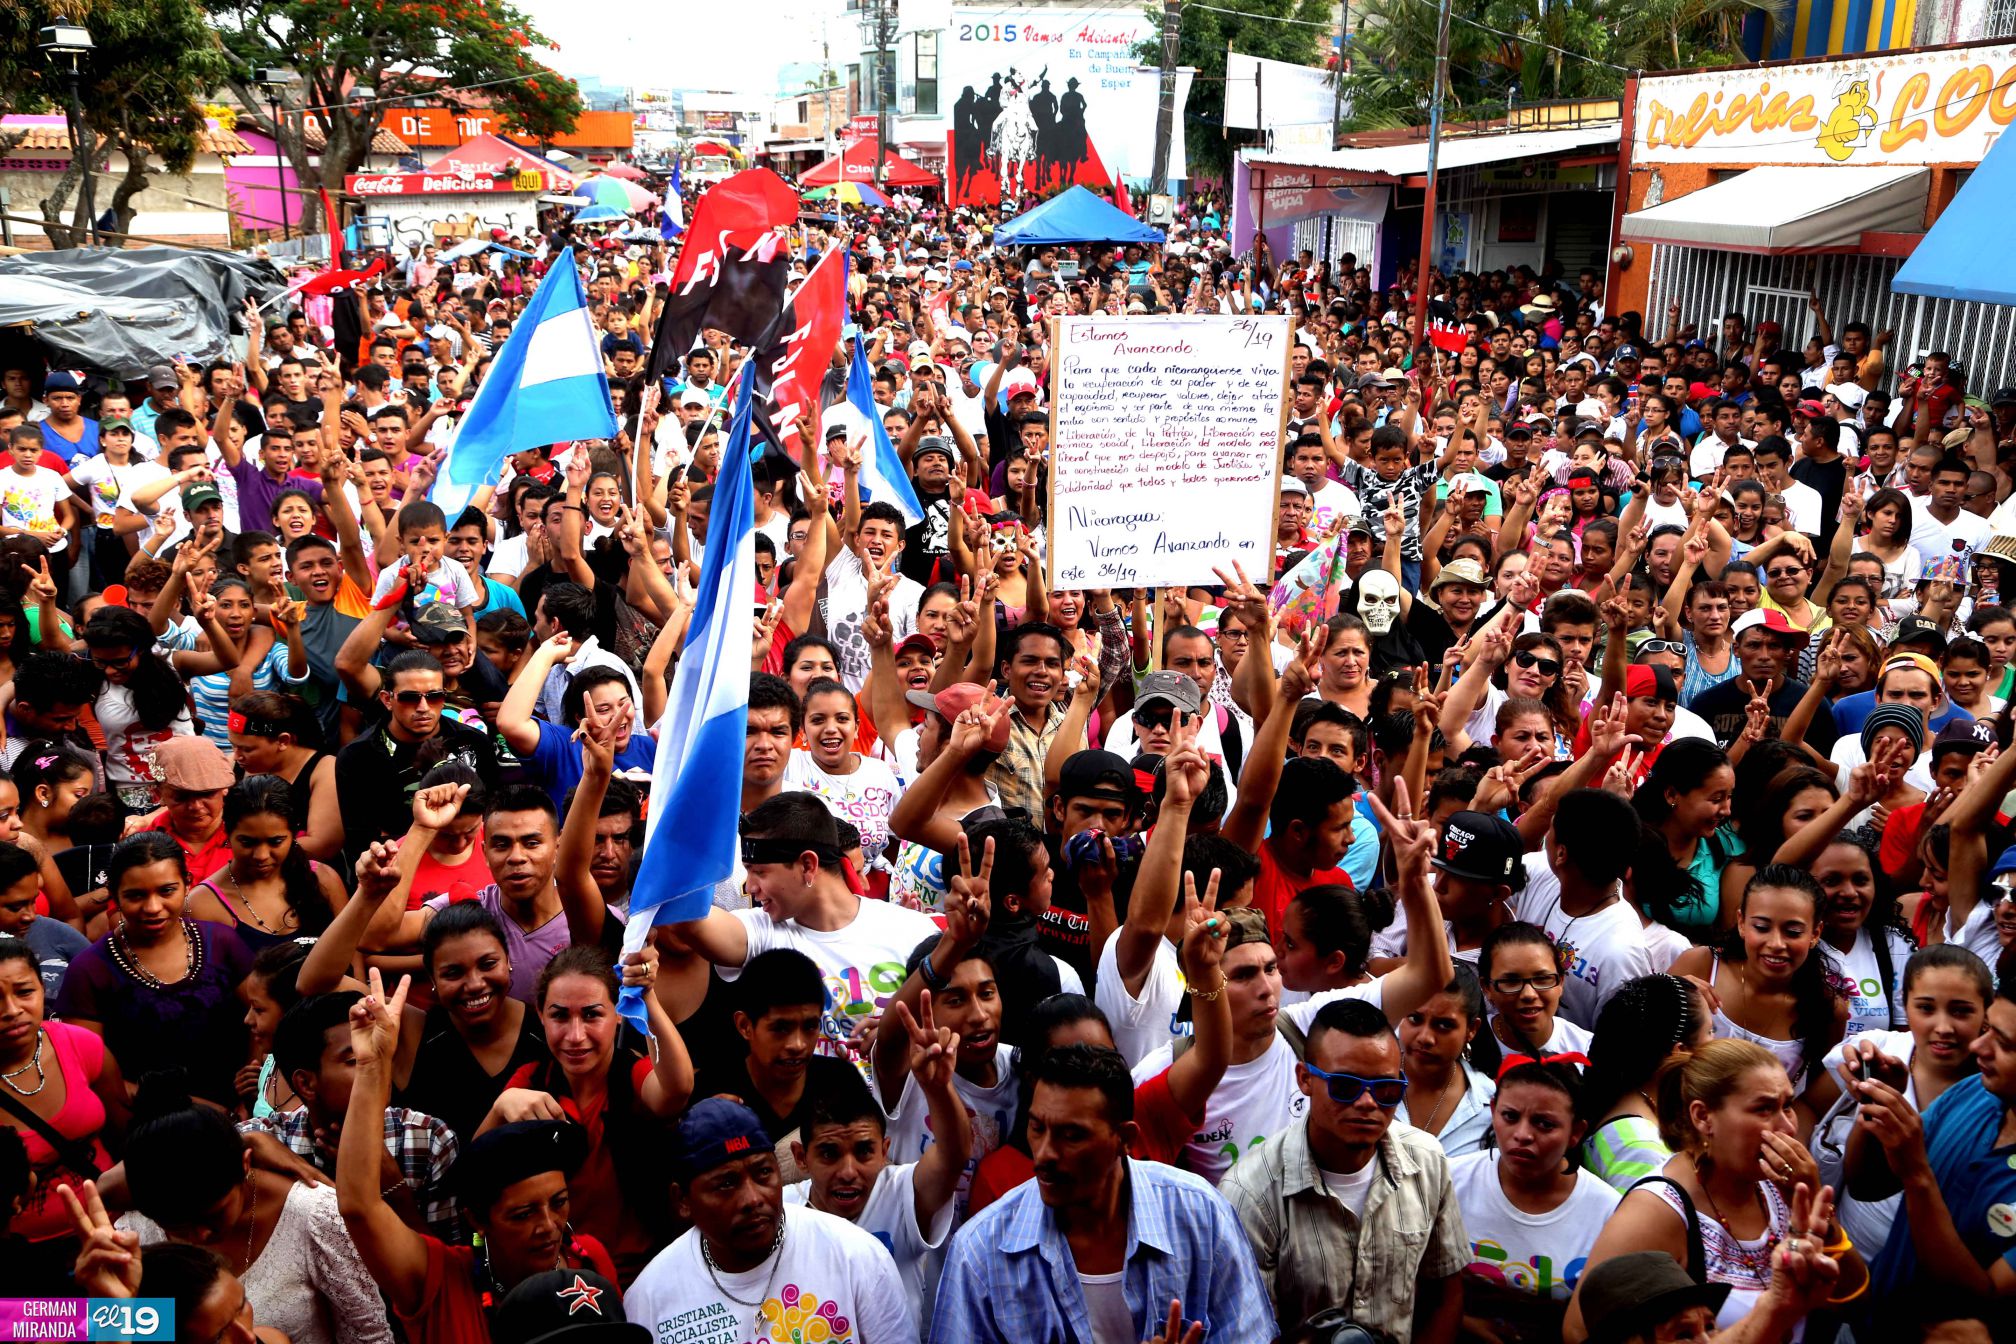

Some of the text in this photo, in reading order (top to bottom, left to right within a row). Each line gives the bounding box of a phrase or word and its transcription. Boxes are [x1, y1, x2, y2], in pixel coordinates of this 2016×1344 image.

[959, 24, 1017, 42] 2015
[1023, 24, 1064, 43] Vamos
[1069, 48, 1082, 58] En
[1089, 64, 1101, 73] de
[1646, 81, 1818, 150] Delicias
[402, 116, 432, 136] DE
[423, 176, 494, 192] Deliciosa
[515, 173, 539, 189] AQUI
[1070, 325, 1129, 344] Estamos
[1064, 355, 1092, 375] Para
[1101, 366, 1120, 381] que
[1128, 361, 1157, 374] cada
[1251, 363, 1280, 375] viva
[1064, 375, 1268, 393] la recuperación de su poder y de su
[1060, 389, 1118, 404] capacidad,
[1122, 391, 1167, 401] recuperar
[1177, 391, 1213, 401] valores,
[1217, 390, 1244, 404] dejar
[1060, 403, 1068, 413] el
[1149, 400, 1173, 413] parte
[1183, 402, 1193, 410] de
[1113, 413, 1146, 424] sentido
[1165, 412, 1210, 425] propósitos
[1125, 428, 1137, 438] de
[1146, 427, 1155, 437] la
[1203, 425, 1256, 438] Liberación
[1100, 438, 1134, 449] social,
[1142, 437, 1191, 447] Liberación
[1198, 438, 1210, 447] del
[1217, 438, 1252, 447] modelo
[1058, 451, 1089, 462] liberal
[1094, 454, 1112, 466] que
[1119, 453, 1135, 461] nos
[1184, 450, 1207, 461] para
[1058, 457, 1266, 475] la construcción del modelo de Justicia y
[1119, 482, 1134, 493] que
[1182, 473, 1208, 483] todos
[1086, 531, 1255, 558] Vamos Avanzando en
[1061, 566, 1086, 580] este
[1916, 619, 1937, 631] CAT
[1448, 831, 1467, 844] BULLS
[1449, 824, 1475, 841] CHICAGO
[724, 1135, 750, 1153] NBA
